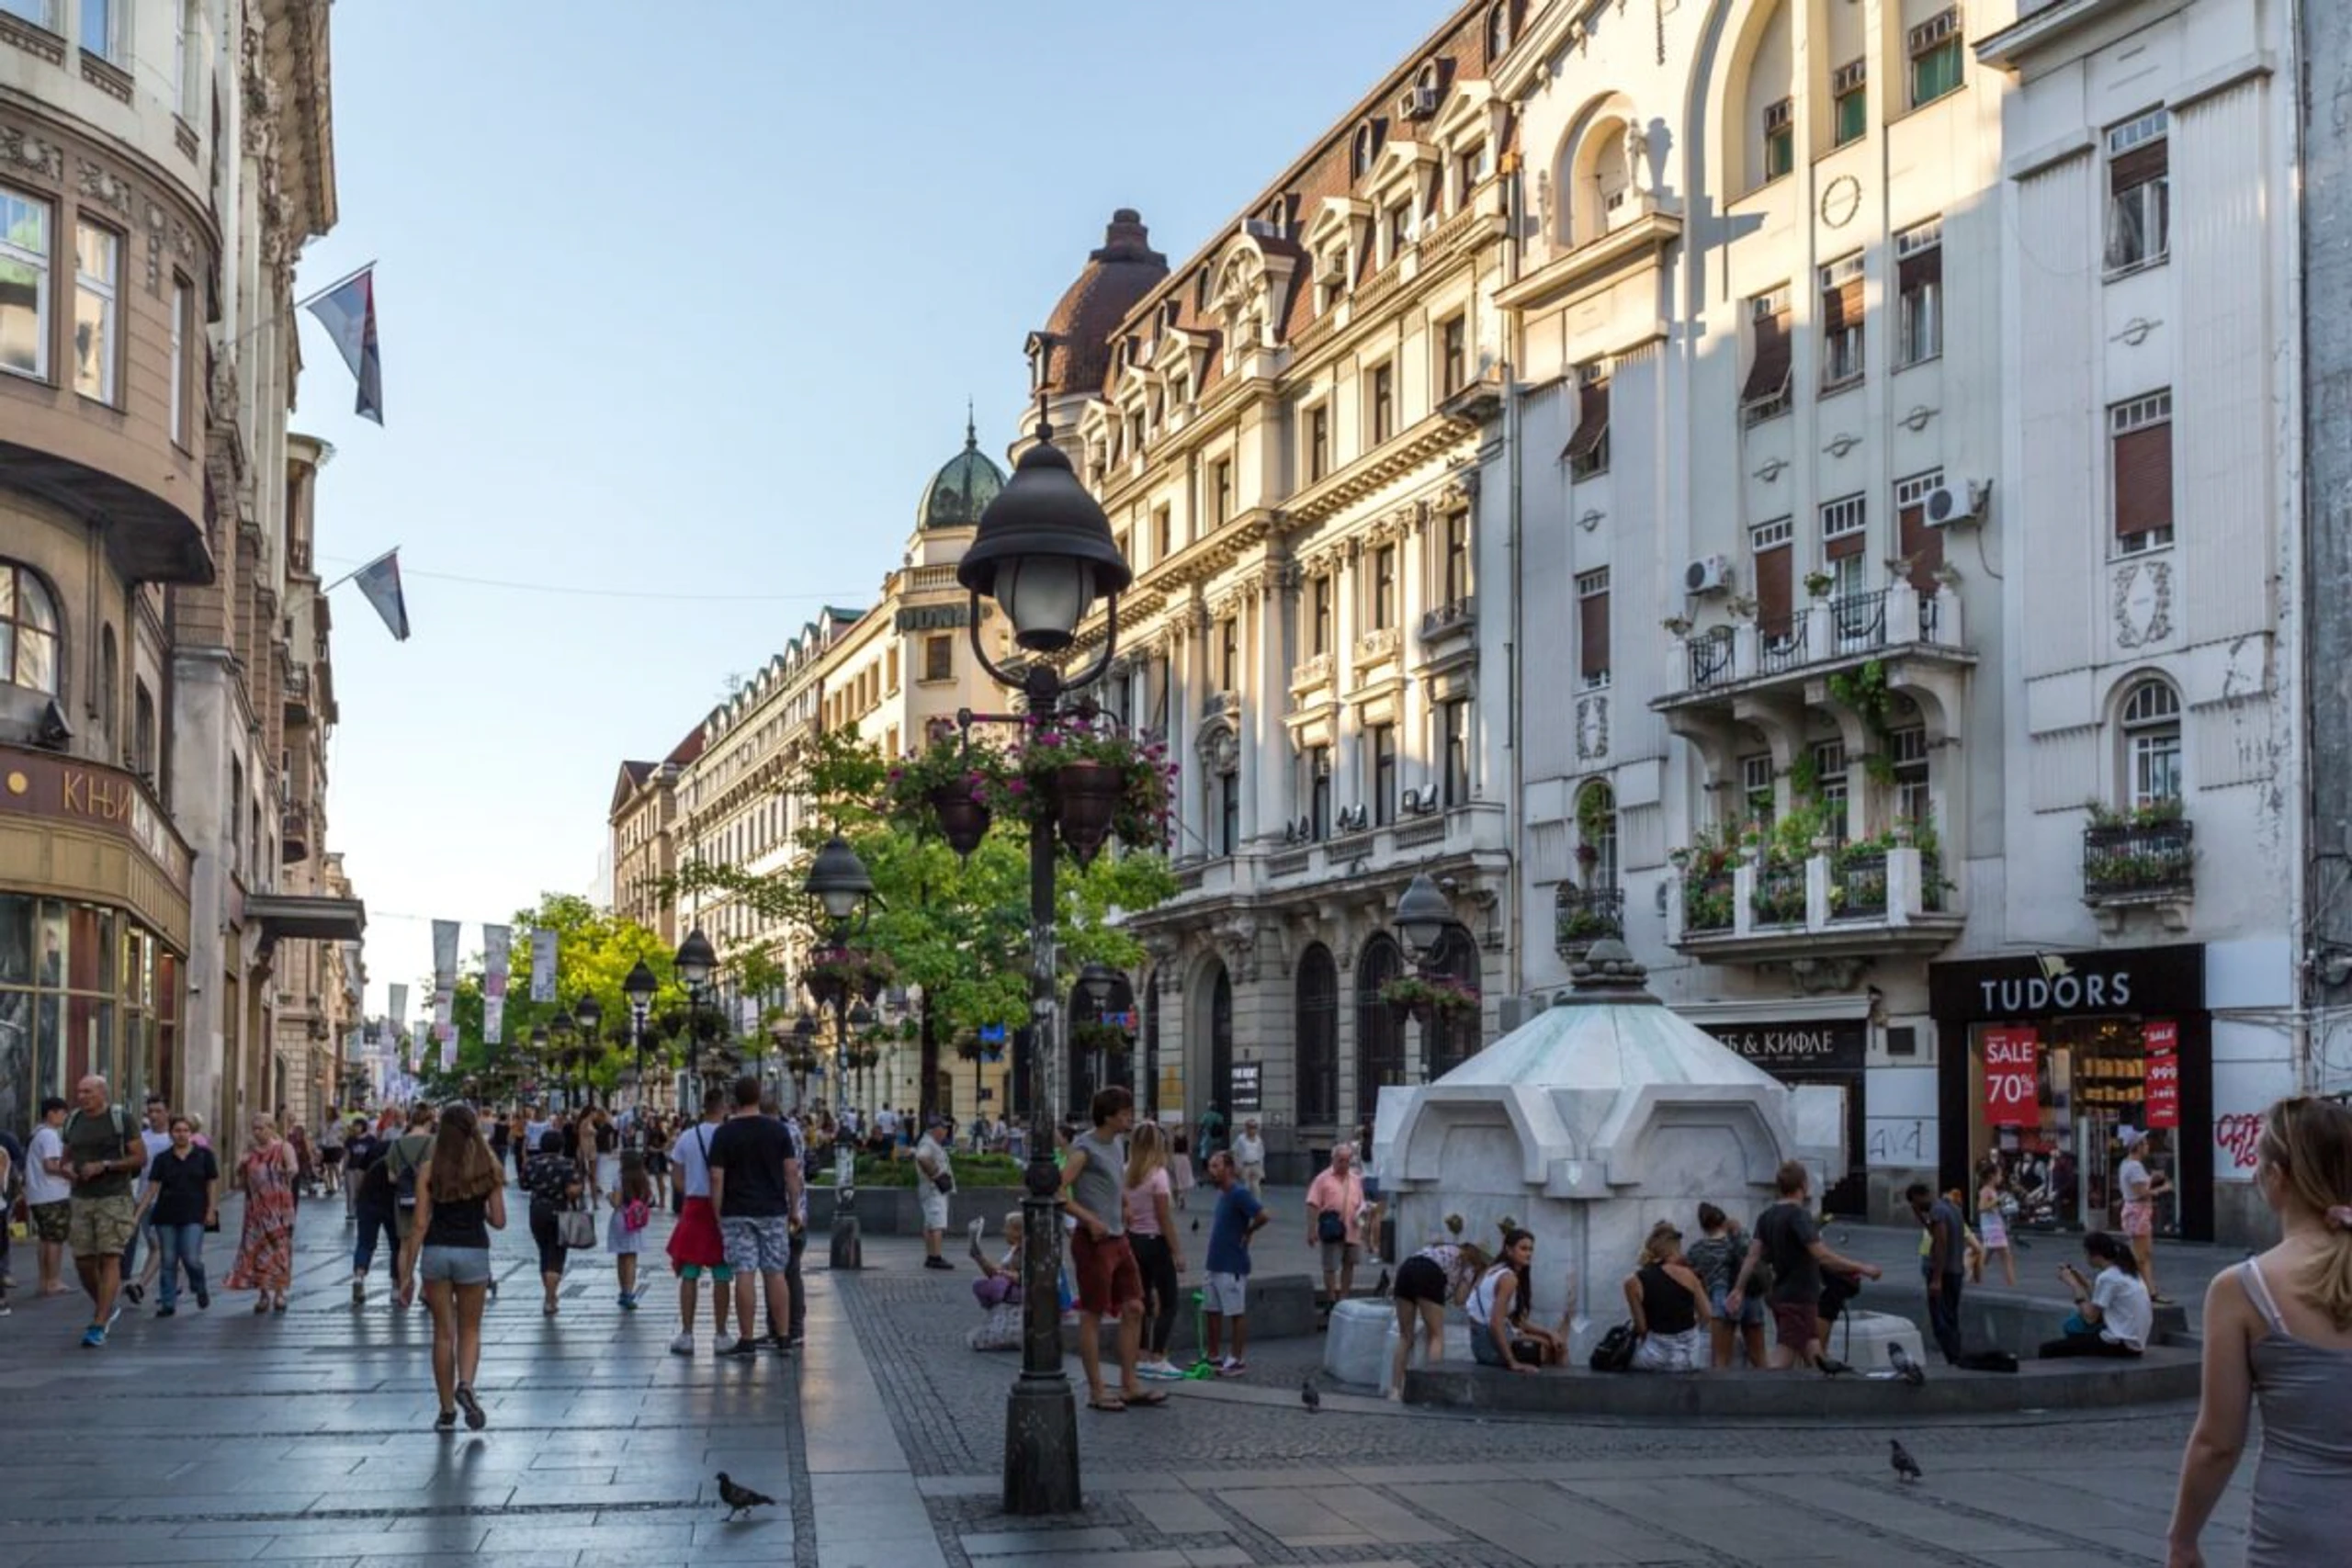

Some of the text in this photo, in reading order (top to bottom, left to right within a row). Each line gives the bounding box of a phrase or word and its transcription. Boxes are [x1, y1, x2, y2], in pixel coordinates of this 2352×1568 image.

[1980, 971, 2131, 1012] TUDORS
[1744, 1033, 1759, 1055] &
[1764, 1029, 1835, 1055] КИФЛЕ
[1986, 1041, 2033, 1065] SALE
